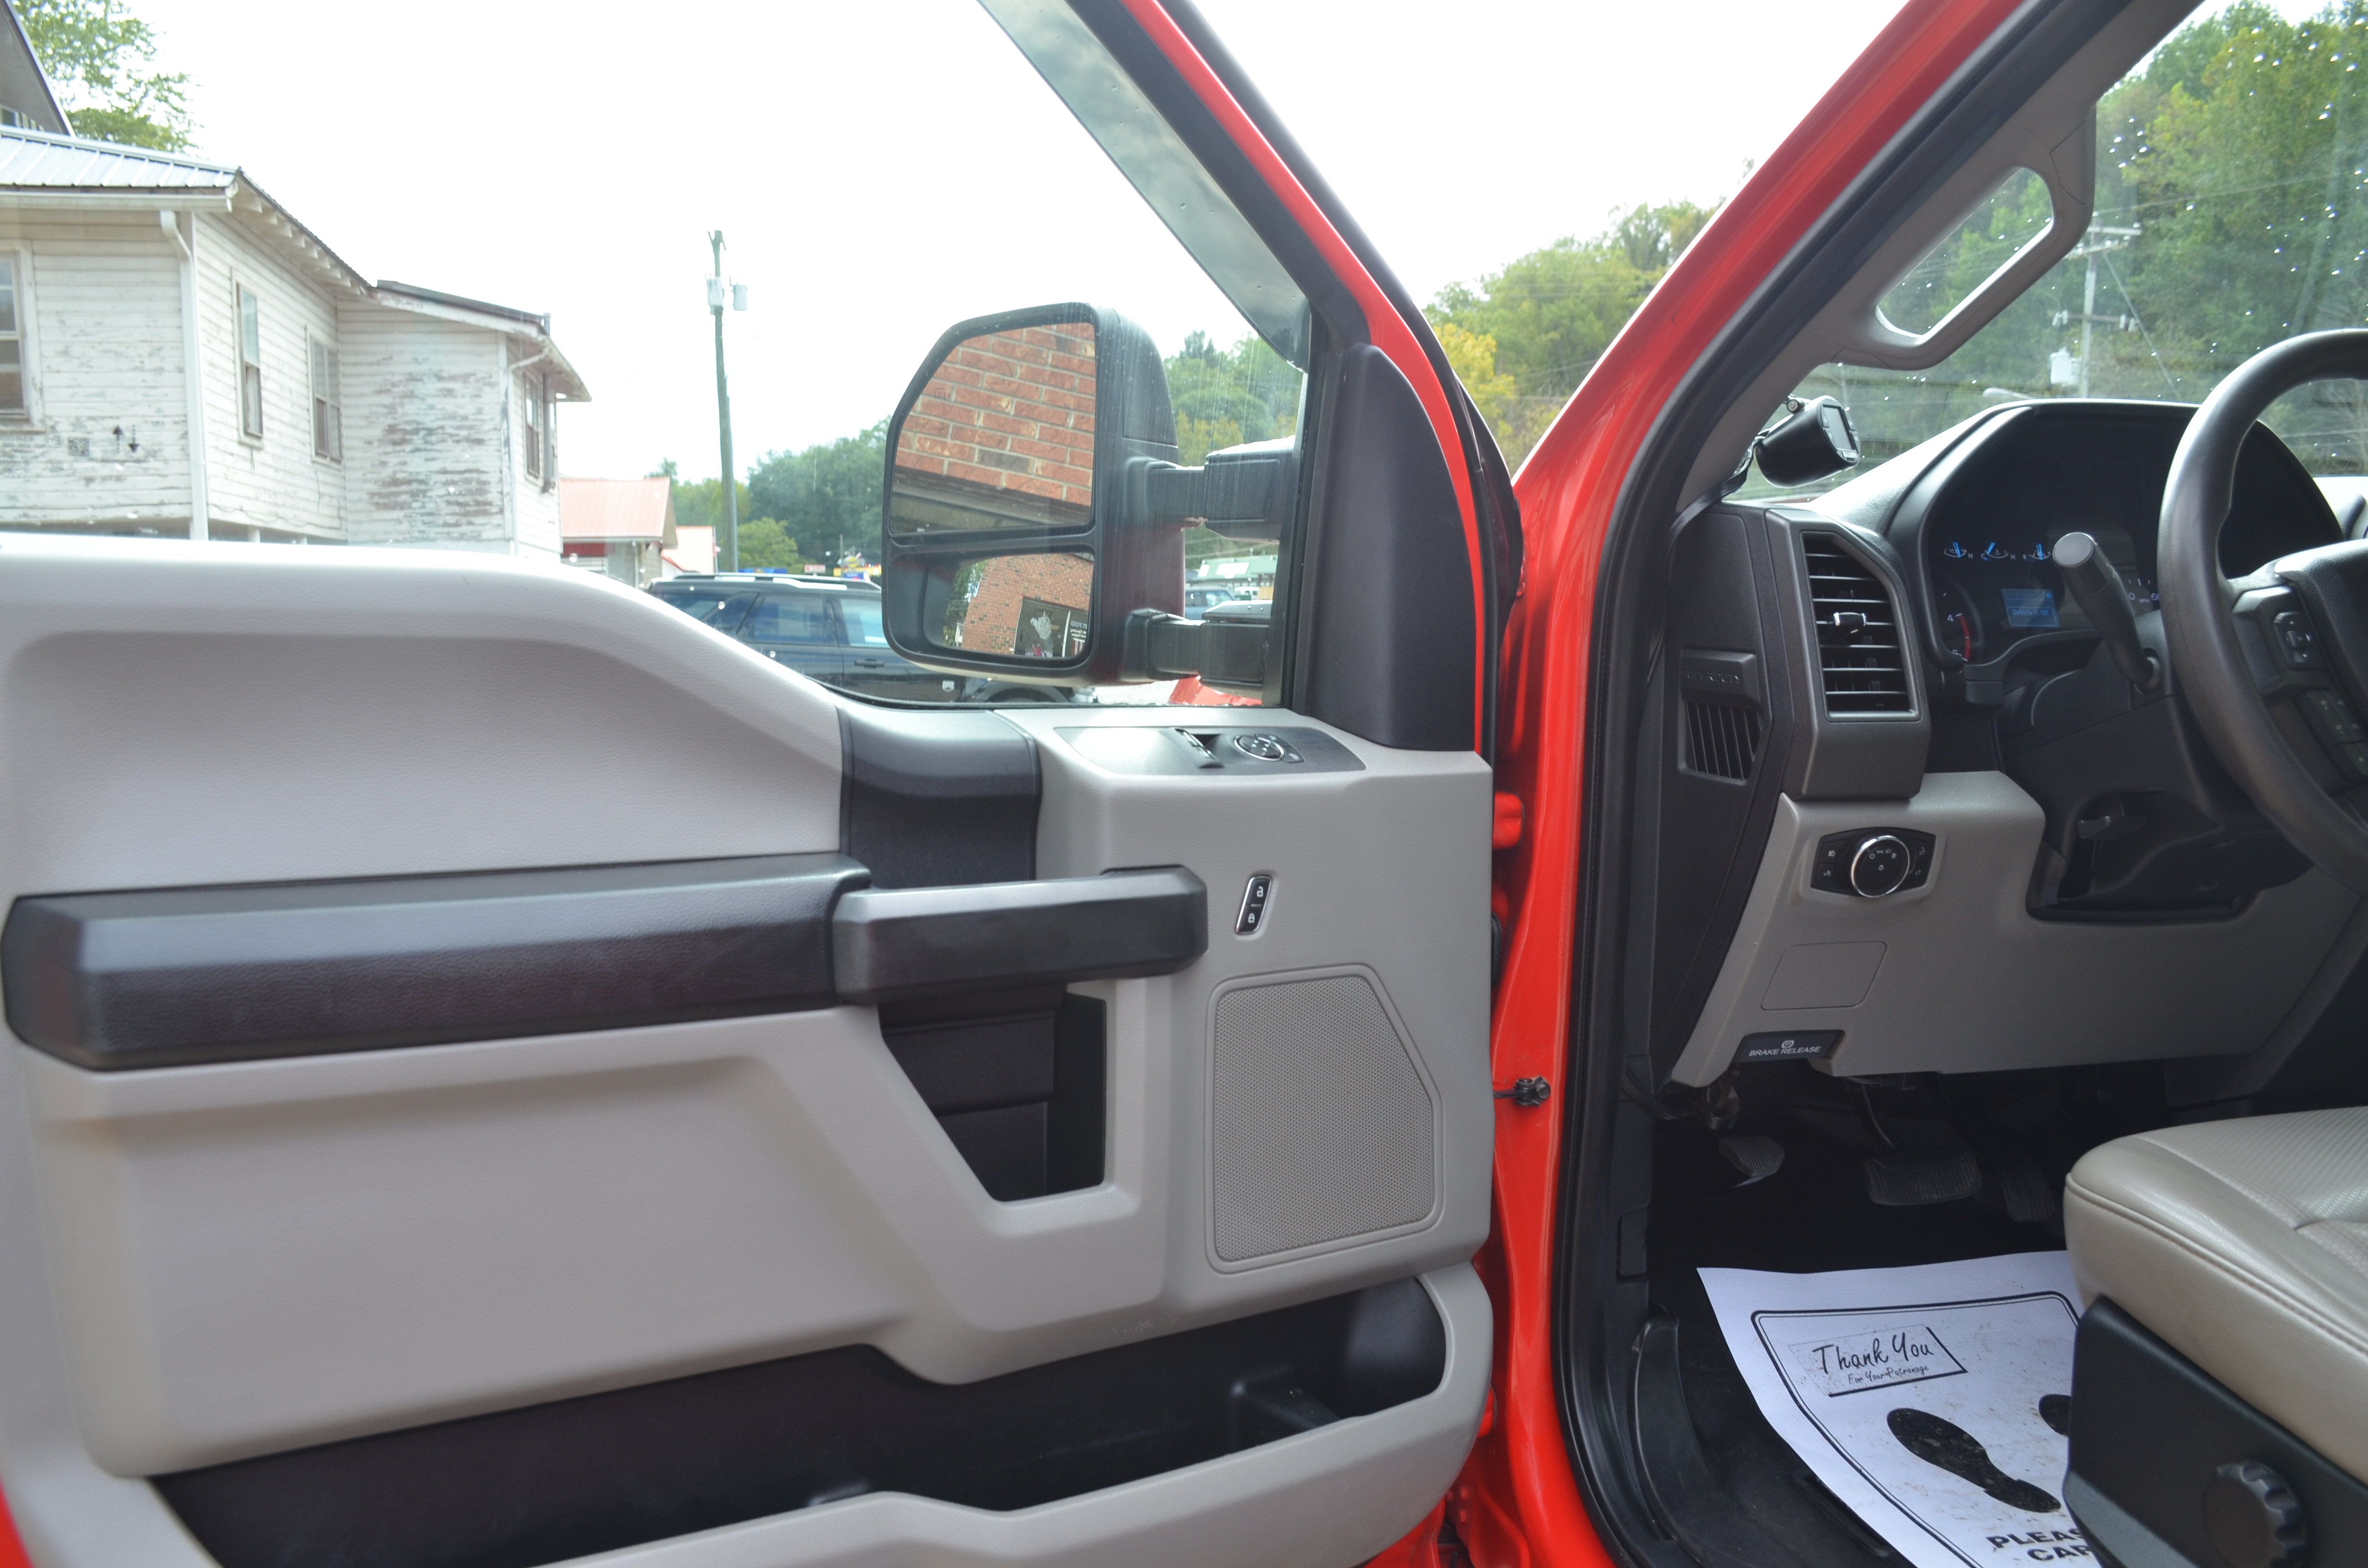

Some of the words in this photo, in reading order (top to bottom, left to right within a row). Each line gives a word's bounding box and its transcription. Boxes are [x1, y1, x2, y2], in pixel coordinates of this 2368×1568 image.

[1947, 614, 1954, 623] 4
[1749, 1049, 1779, 1057] BRAKE
[1780, 1046, 1822, 1054] RELEASE
[1812, 1338, 1889, 1375] Thank
[1892, 1332, 1935, 1361] You
[1848, 1373, 1864, 1384] For
[1865, 1371, 1885, 1382] Your
[1887, 1365, 1929, 1378] Patronage
[1986, 1528, 2084, 1548] PLEAS
